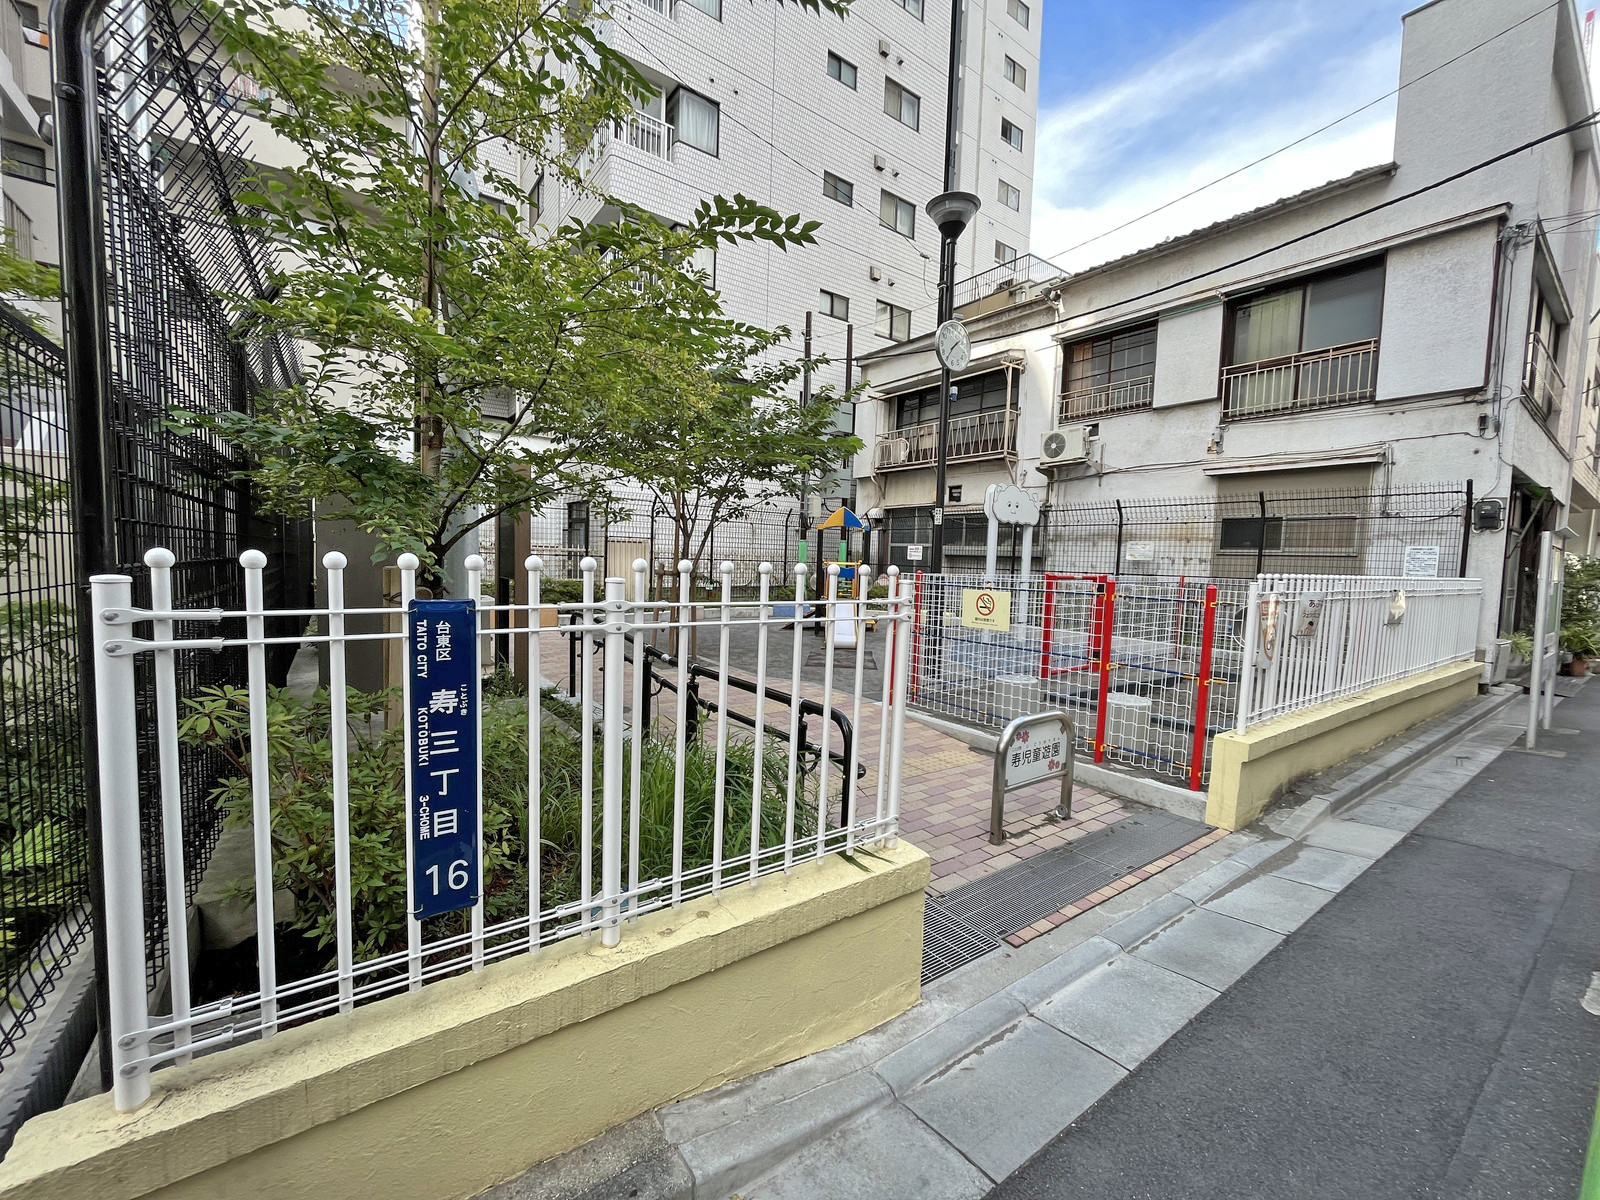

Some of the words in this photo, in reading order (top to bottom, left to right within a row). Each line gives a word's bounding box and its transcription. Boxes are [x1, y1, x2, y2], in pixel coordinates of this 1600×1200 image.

[416, 619, 428, 651] TAITO
[435, 620, 452, 662] 台東区
[417, 654, 428, 678] CITY
[460, 683, 469, 716] ことぶき
[417, 707, 430, 766] KOTOBUKI
[1011, 741, 1061, 768] 寿児童遊園
[428, 688, 460, 838] 寿三丁目
[419, 794, 431, 841] 3-CHOME
[425, 859, 469, 896] 16
